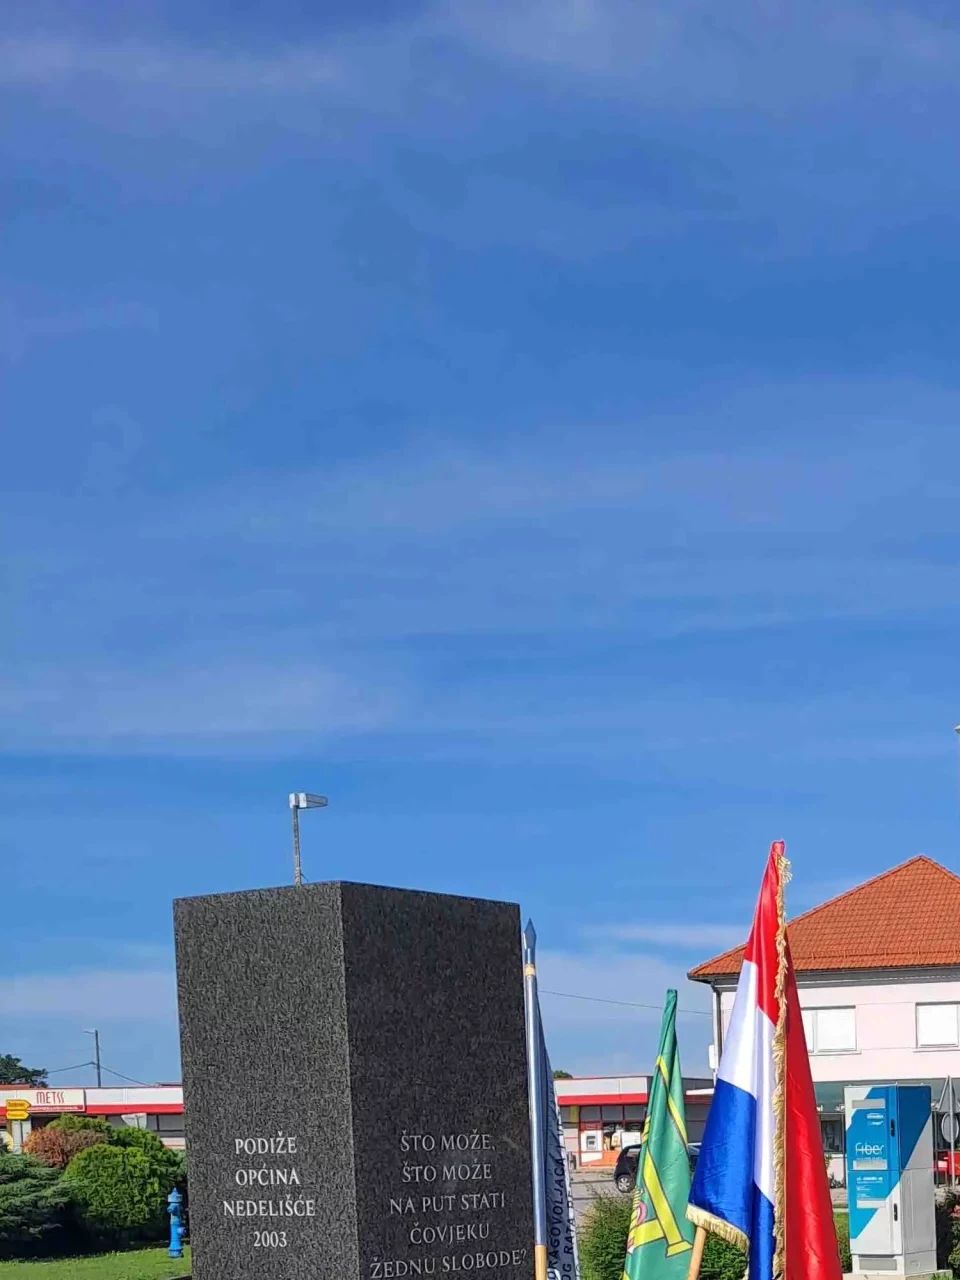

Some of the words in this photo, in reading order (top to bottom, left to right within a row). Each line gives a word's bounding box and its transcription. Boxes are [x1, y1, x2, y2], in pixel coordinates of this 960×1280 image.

[235, 1131, 297, 1154] PODIŽE
[400, 1130, 435, 1152] ŠTO
[441, 1128, 496, 1151] MOŽE,
[235, 1163, 301, 1185] OPĆINA
[402, 1161, 437, 1183] ŠTO
[442, 1158, 492, 1181] MOŽE
[223, 1194, 316, 1216] NEDELIŠĆE
[390, 1198, 416, 1215] NA
[422, 1195, 456, 1212] PUT
[460, 1192, 505, 1211] STATI
[253, 1231, 287, 1247] 2003
[410, 1222, 490, 1244] ČOVJEKU
[370, 1257, 435, 1279] ŽEDNU
[442, 1248, 527, 1273] SLOBODE?
